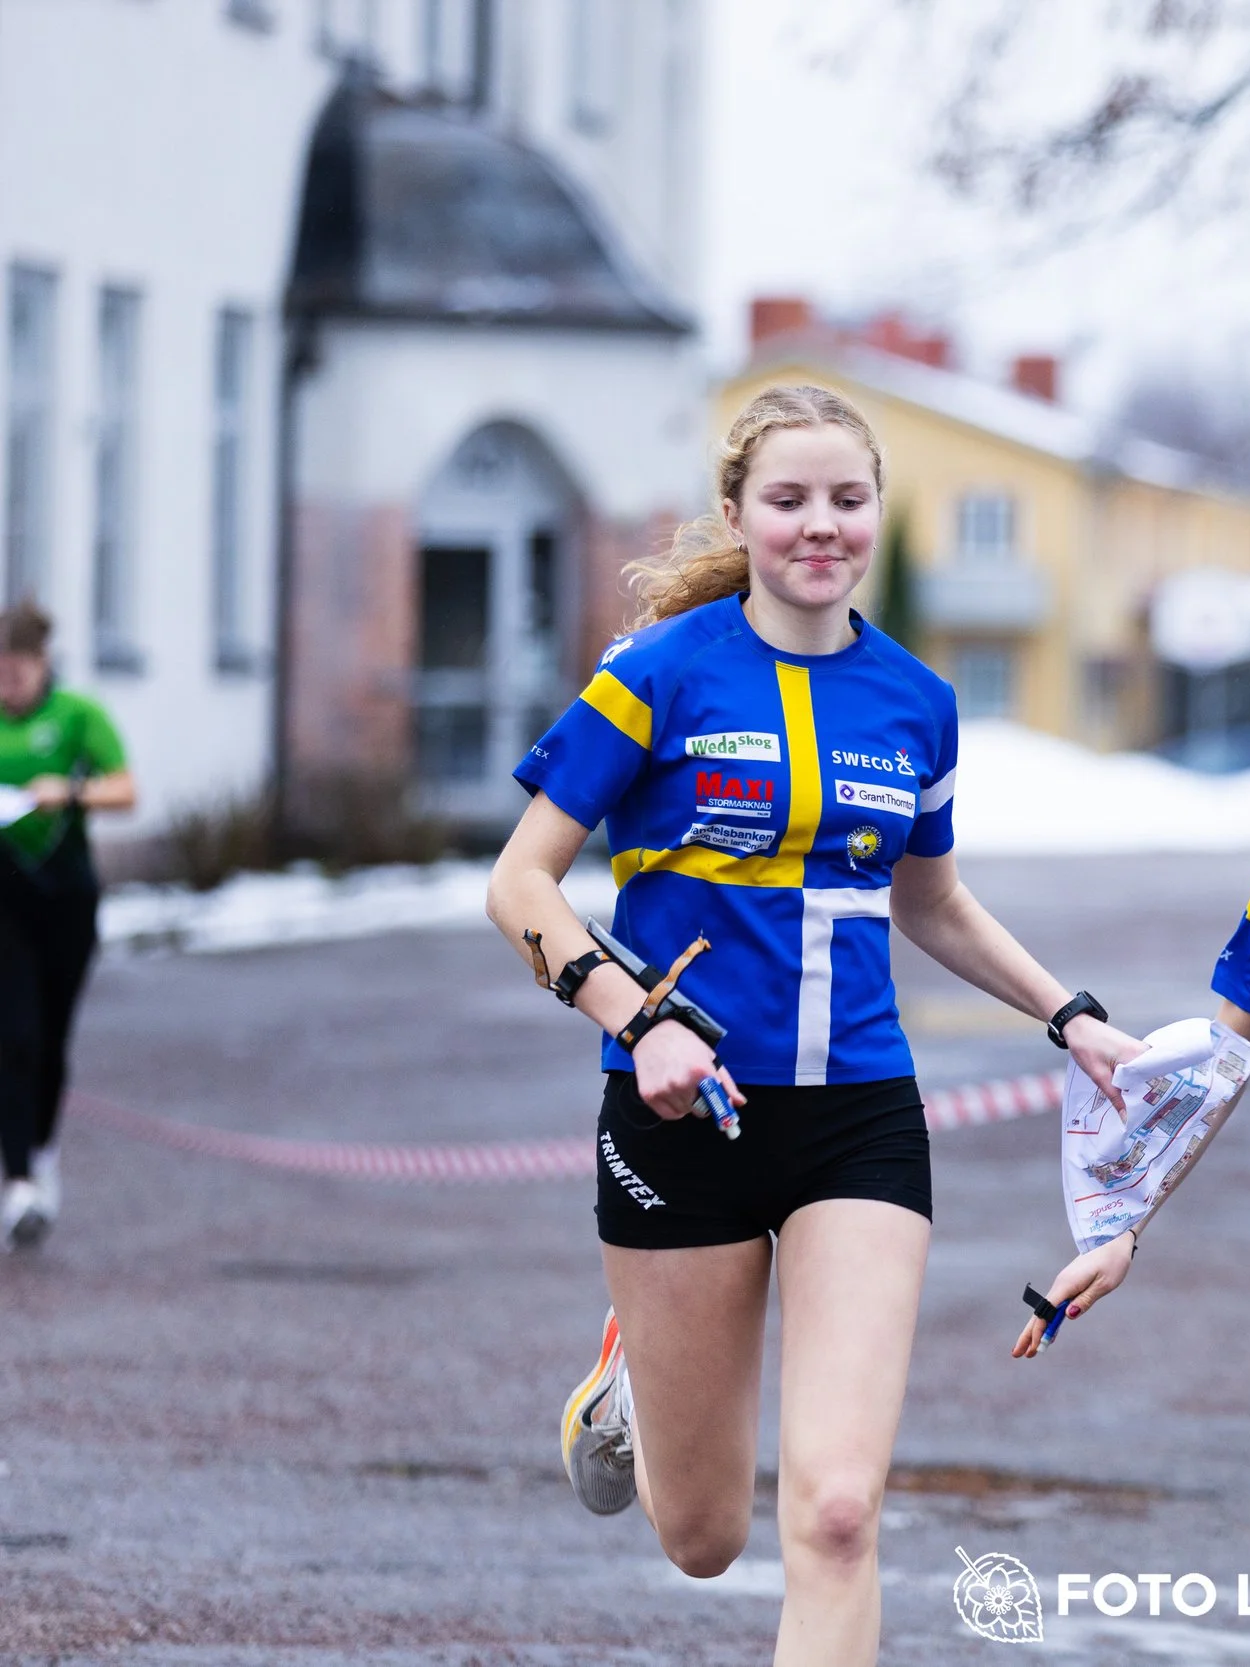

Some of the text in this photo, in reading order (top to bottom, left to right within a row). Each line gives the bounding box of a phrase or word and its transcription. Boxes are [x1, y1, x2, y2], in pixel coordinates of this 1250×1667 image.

[831, 750, 894, 772] SWECO
[696, 771, 774, 801] MAXI
[859, 790, 886, 804] Grant
[708, 798, 772, 811] STORMARKNAD
[600, 1130, 666, 1210] TRIMTEX
